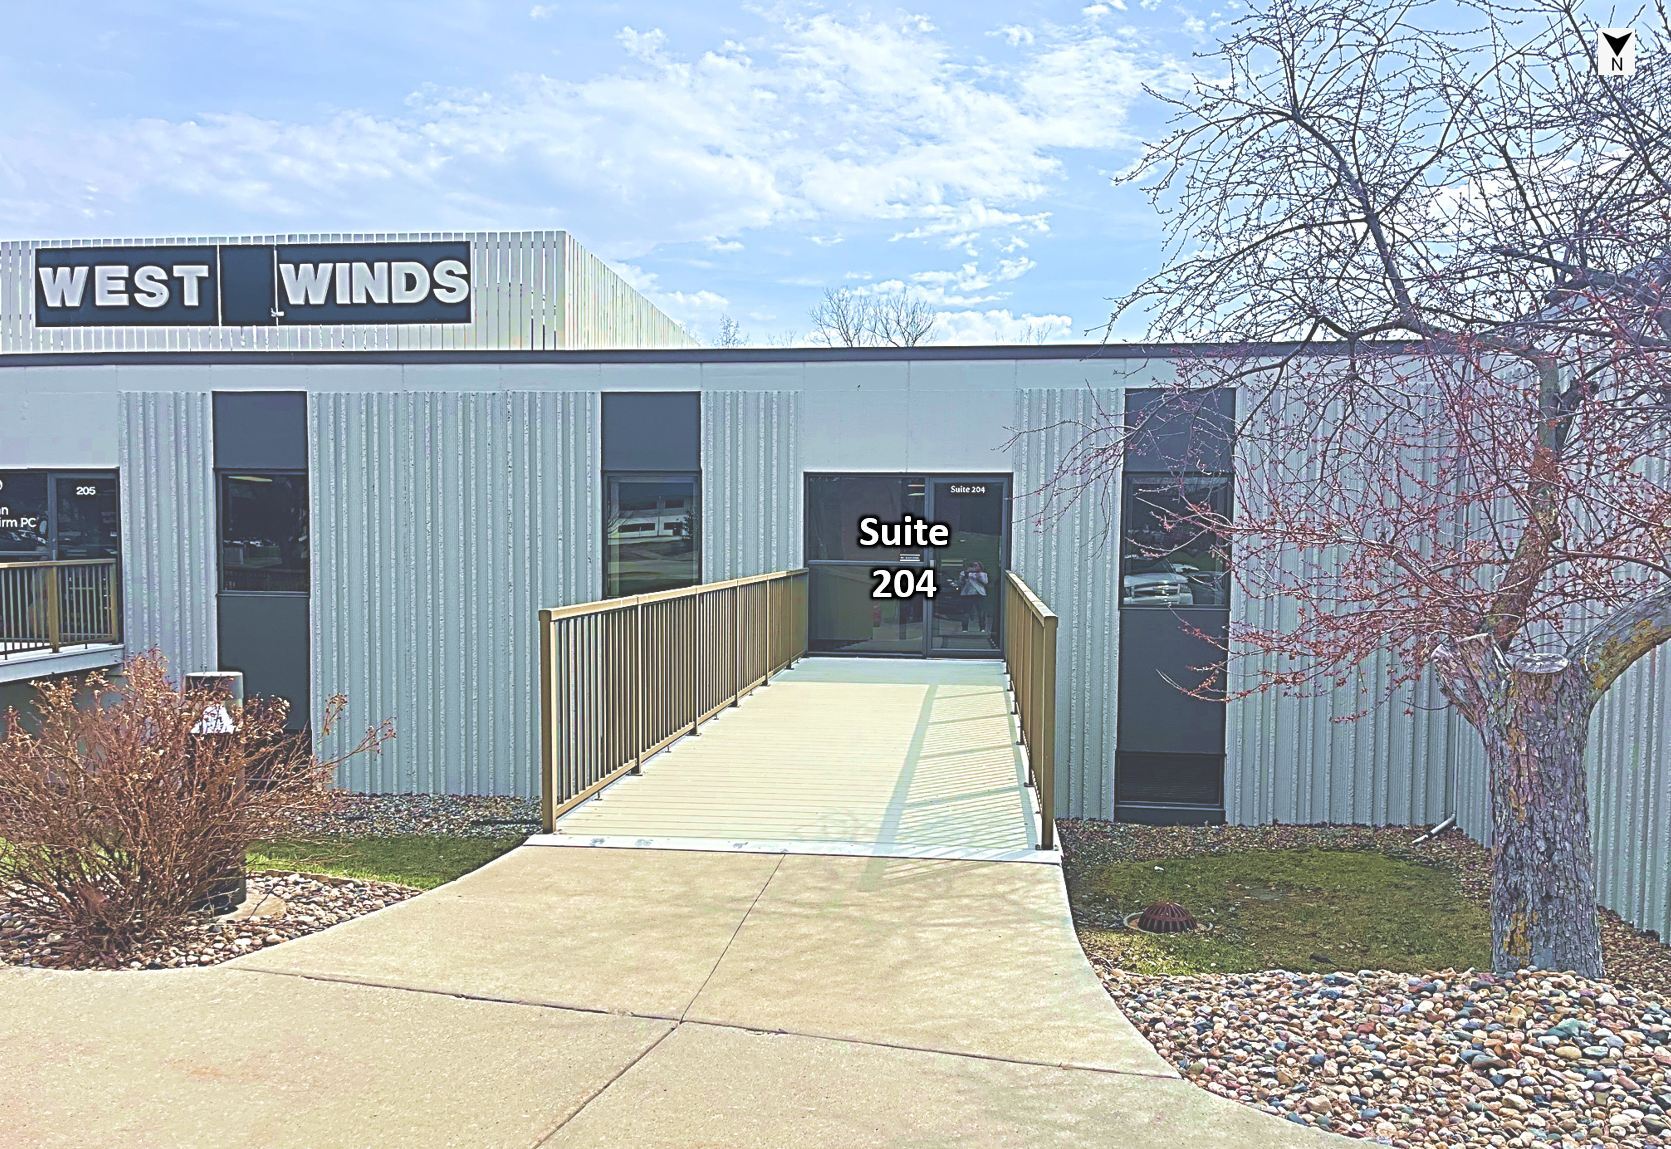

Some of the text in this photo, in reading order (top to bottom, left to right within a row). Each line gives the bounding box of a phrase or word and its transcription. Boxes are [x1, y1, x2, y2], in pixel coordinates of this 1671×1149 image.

[38, 260, 469, 308] WEST WINDS
[76, 486, 96, 496] 205
[950, 485, 986, 494] Suite 204
[20, 517, 37, 528] PC
